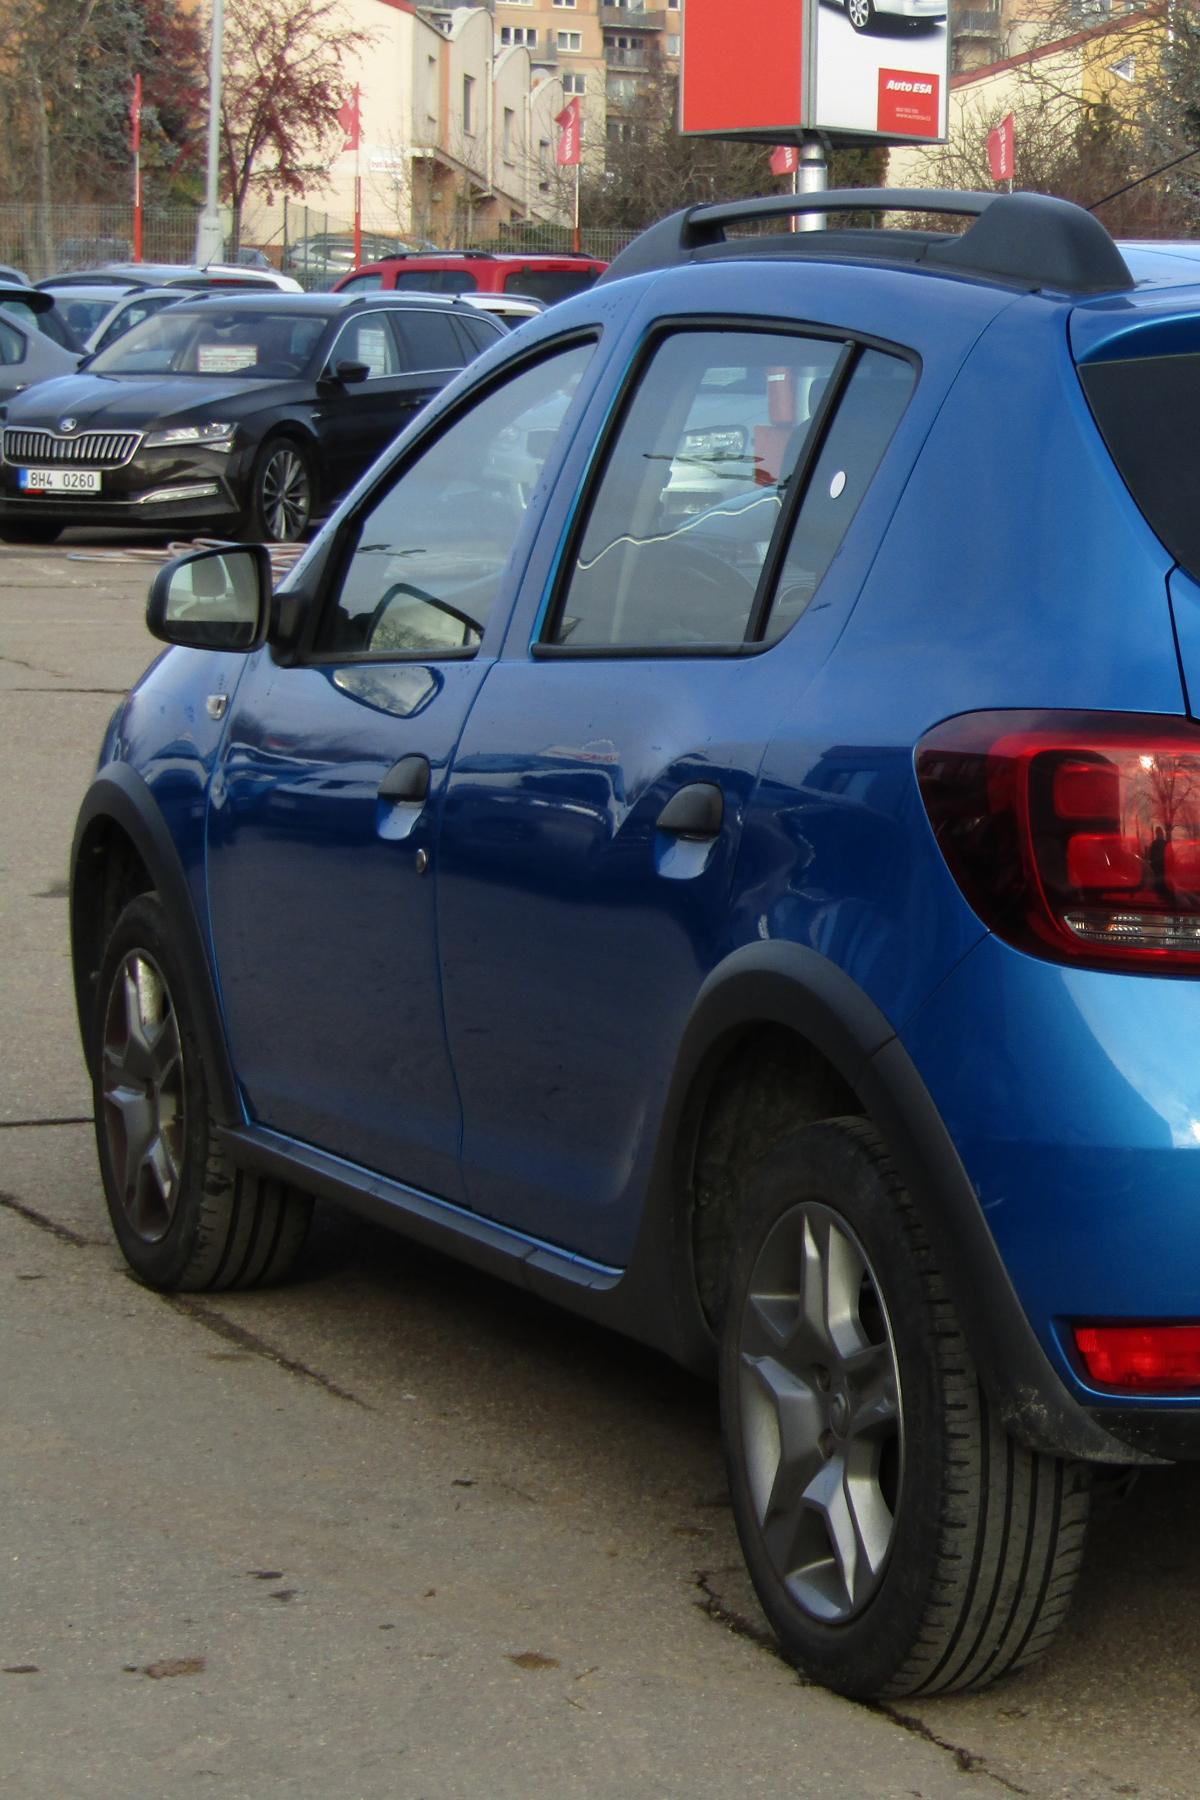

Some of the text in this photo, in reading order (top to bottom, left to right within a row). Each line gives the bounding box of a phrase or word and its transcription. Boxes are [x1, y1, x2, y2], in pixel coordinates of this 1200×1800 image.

[886, 80, 933, 95] Auto ESA
[30, 472, 95, 488] 8H4 0260
